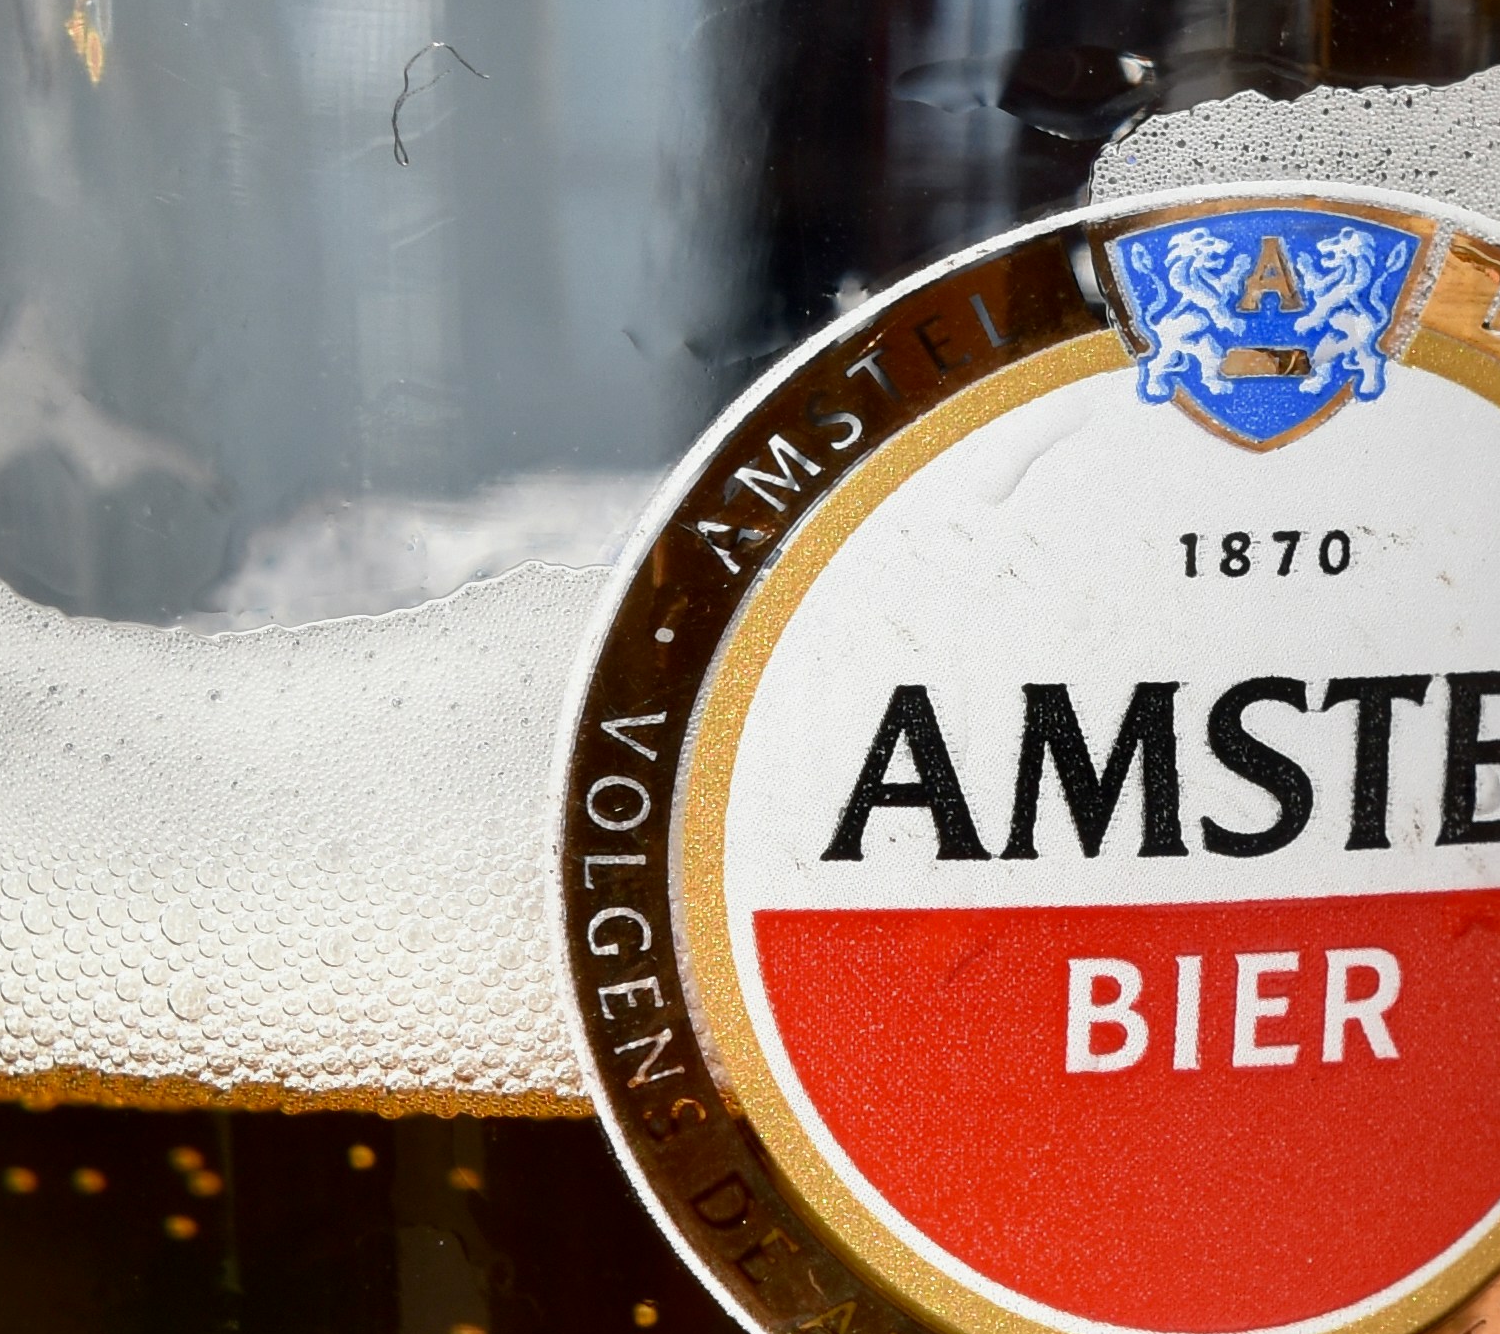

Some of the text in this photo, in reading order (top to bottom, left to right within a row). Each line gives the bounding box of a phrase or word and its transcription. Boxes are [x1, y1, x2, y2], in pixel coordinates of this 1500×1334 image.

[1235, 235, 1306, 312] A
[696, 292, 1014, 576] AMSTEL
[1181, 529, 1353, 579] 1870
[583, 709, 707, 1142] VOLGENS
[691, 1171, 800, 1286] DE
[1065, 946, 1402, 1073] BIER
